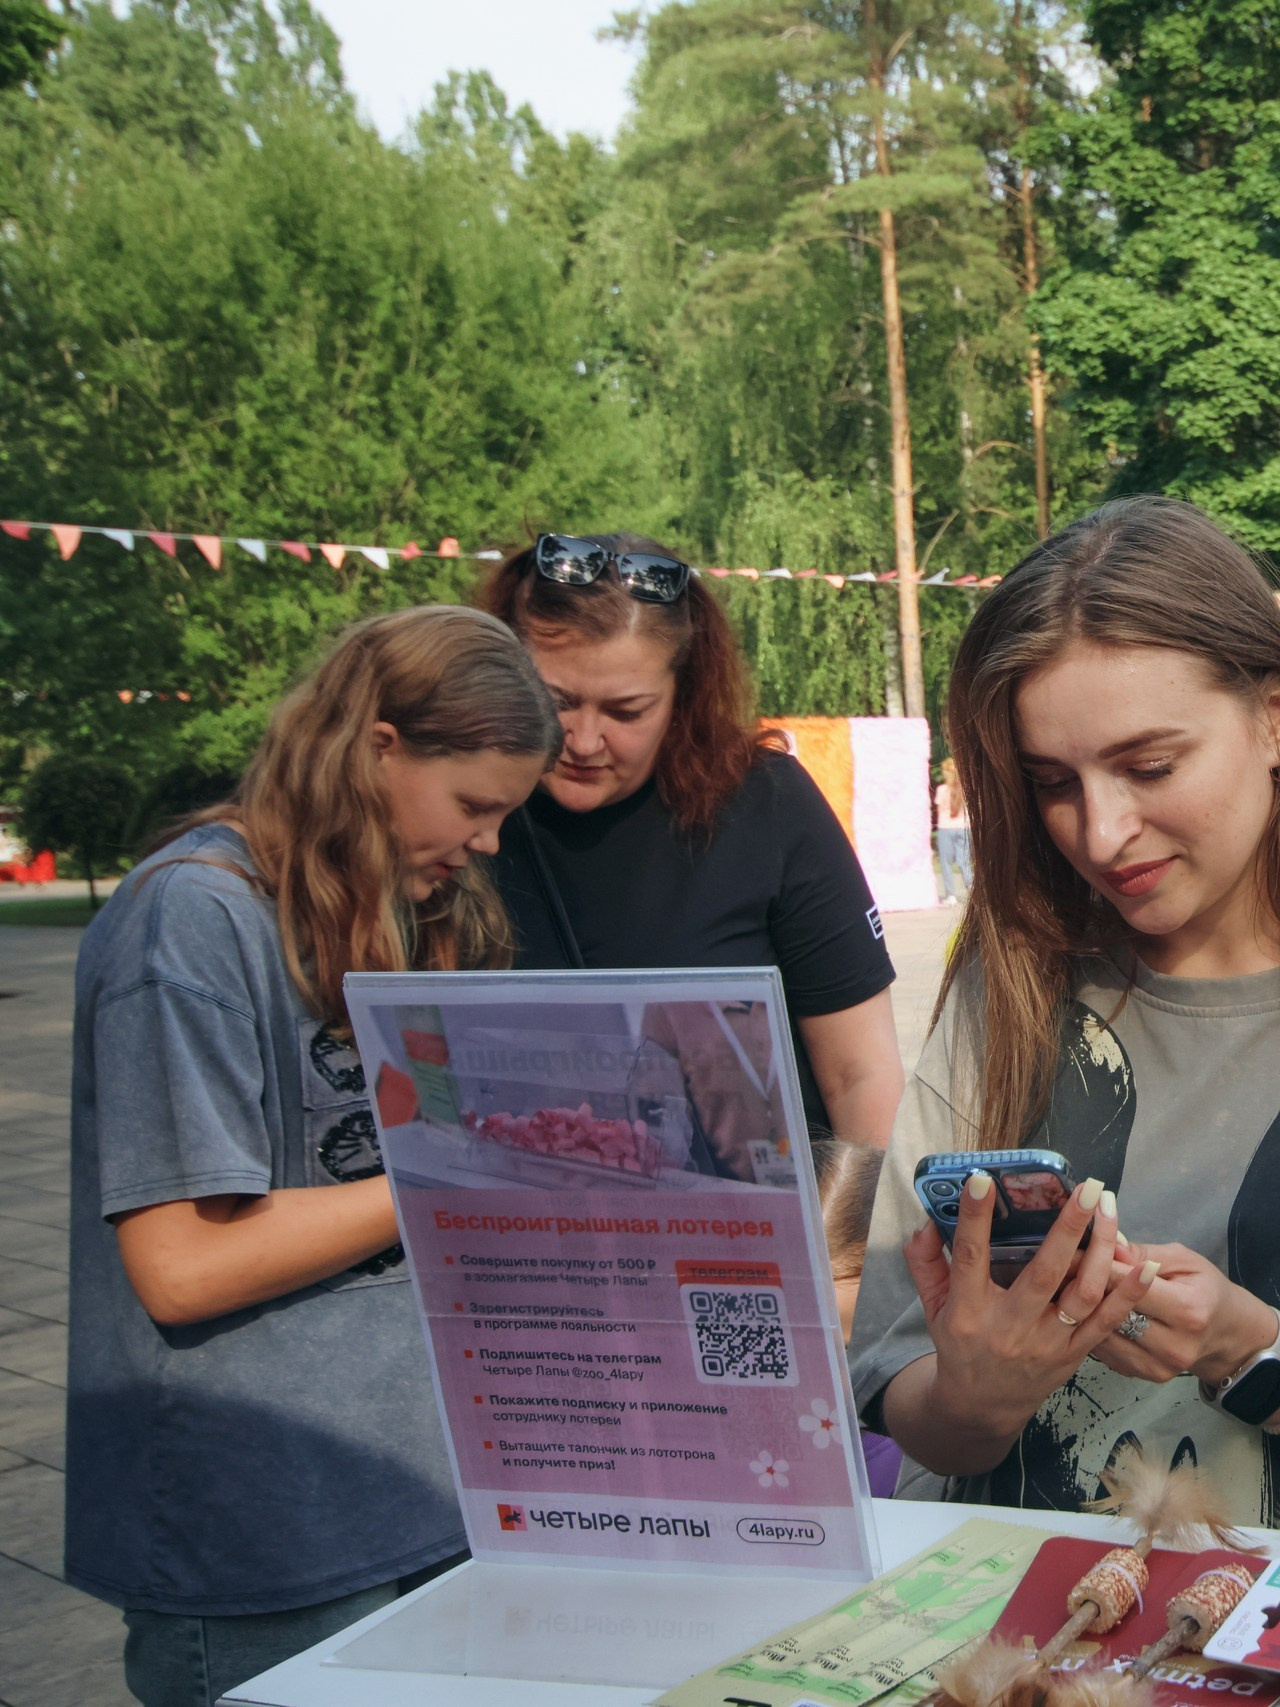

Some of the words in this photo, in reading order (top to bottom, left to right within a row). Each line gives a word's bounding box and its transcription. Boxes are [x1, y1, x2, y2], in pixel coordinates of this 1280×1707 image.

[433, 1210, 660, 1236] Беспроигрышная
[666, 1218, 774, 1239] лотерея
[460, 1254, 538, 1268] Совершите
[541, 1258, 596, 1271] покупку
[598, 1260, 614, 1270] от
[617, 1258, 645, 1270] 500
[464, 1273, 472, 1282] в
[474, 1273, 558, 1284] зоомагазине
[559, 1274, 609, 1287] Четыре
[612, 1275, 648, 1287] Лапы
[689, 1267, 769, 1280] телеграм
[469, 1302, 604, 1317] Зарегистрируйтесь
[474, 1319, 482, 1329] в
[485, 1319, 558, 1331] программе
[560, 1321, 636, 1333] лояльности
[479, 1349, 575, 1361] Подпишитесь
[577, 1353, 593, 1363] на
[595, 1353, 662, 1366] телеграм
[482, 1365, 533, 1377] Четыре
[535, 1366, 570, 1378] Лапы
[572, 1367, 645, 1381] @zoo_4lapy
[489, 1395, 559, 1407] Покажите
[561, 1398, 626, 1411] подписку
[629, 1402, 638, 1411] и
[641, 1402, 728, 1415] приложение
[493, 1413, 567, 1425] сотруднику
[569, 1415, 622, 1426] лотереи
[499, 1440, 565, 1453] Вытащите
[567, 1443, 628, 1456] талончик
[630, 1447, 646, 1457] из
[648, 1448, 716, 1461] лототрона
[502, 1458, 511, 1467] и
[513, 1459, 576, 1470] получите
[579, 1460, 616, 1471] приз!
[530, 1509, 631, 1533] четыре
[639, 1516, 710, 1538] лапы
[749, 1523, 815, 1540] 4lapy.ru
[1103, 1658, 1263, 1696] petmx
